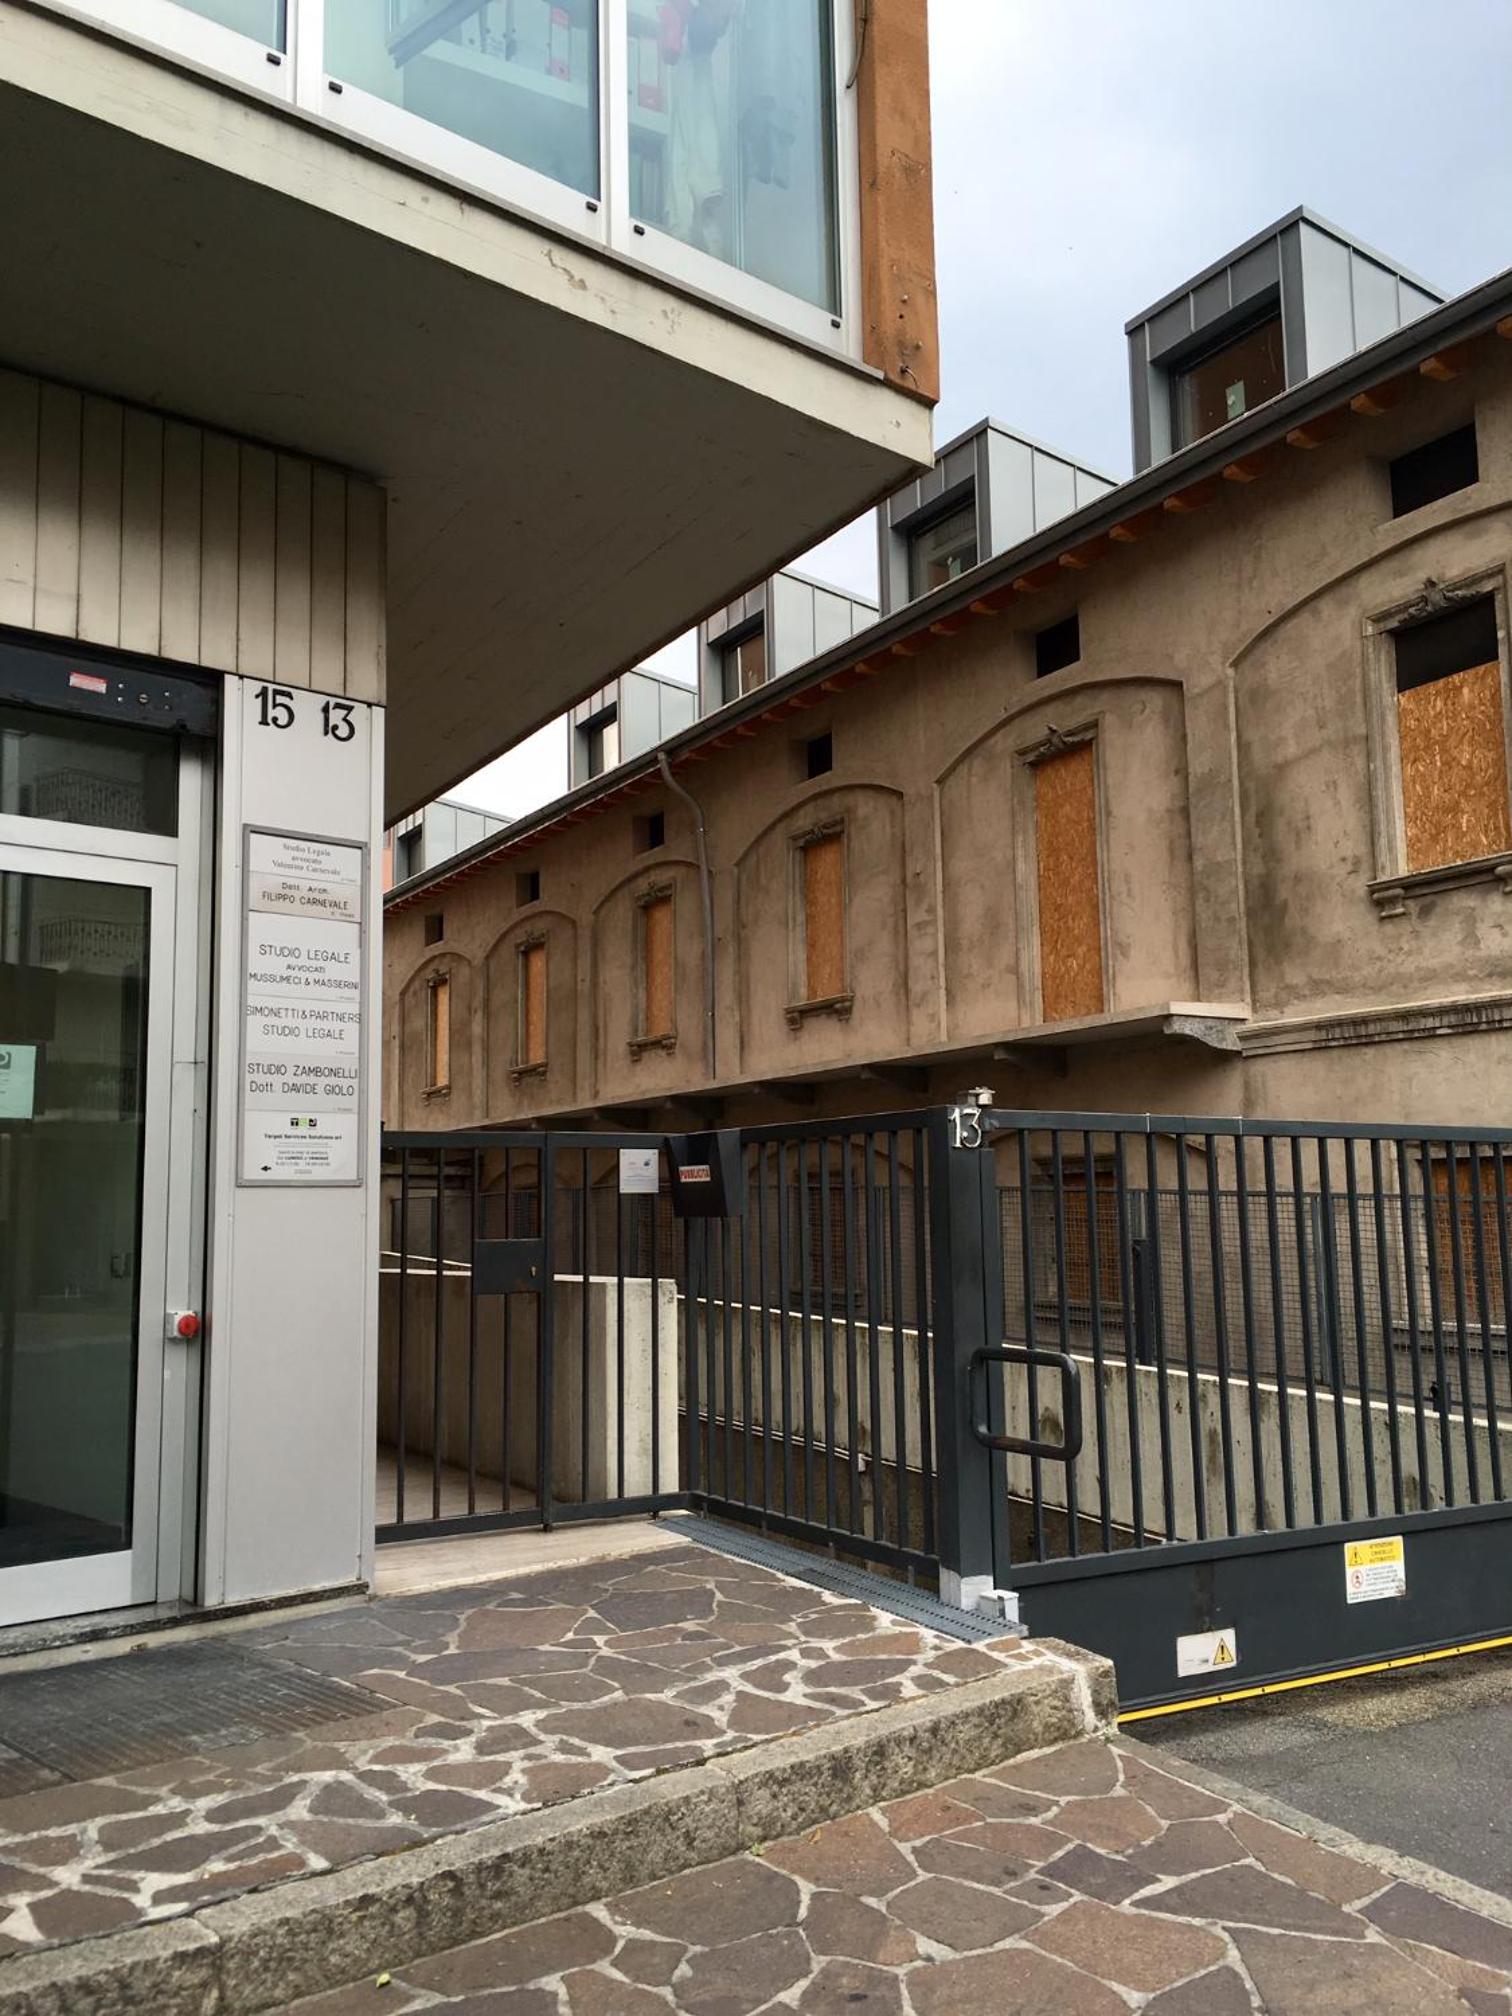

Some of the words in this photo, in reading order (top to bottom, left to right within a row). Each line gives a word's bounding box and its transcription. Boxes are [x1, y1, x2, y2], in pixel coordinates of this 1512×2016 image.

[254, 685, 295, 729] 15
[321, 700, 355, 742] 13
[262, 891, 295, 904] FILIPPO
[300, 896, 349, 911] CARNEVALE
[259, 944, 301, 959] STUDIO
[307, 949, 351, 964] LEGALE
[286, 964, 326, 973] AVVOCATI
[249, 972, 302, 985] MUSSUMECI
[304, 978, 311, 986] &
[262, 1023, 300, 1038] STUDIO
[306, 1028, 344, 1041] LEGALE
[247, 1062, 287, 1076] STUDIO
[292, 1065, 358, 1079] ZAMBONELLI
[282, 1082, 318, 1095] DAVIDE
[324, 1084, 355, 1096] GIOLO
[947, 1107, 982, 1148] 13
